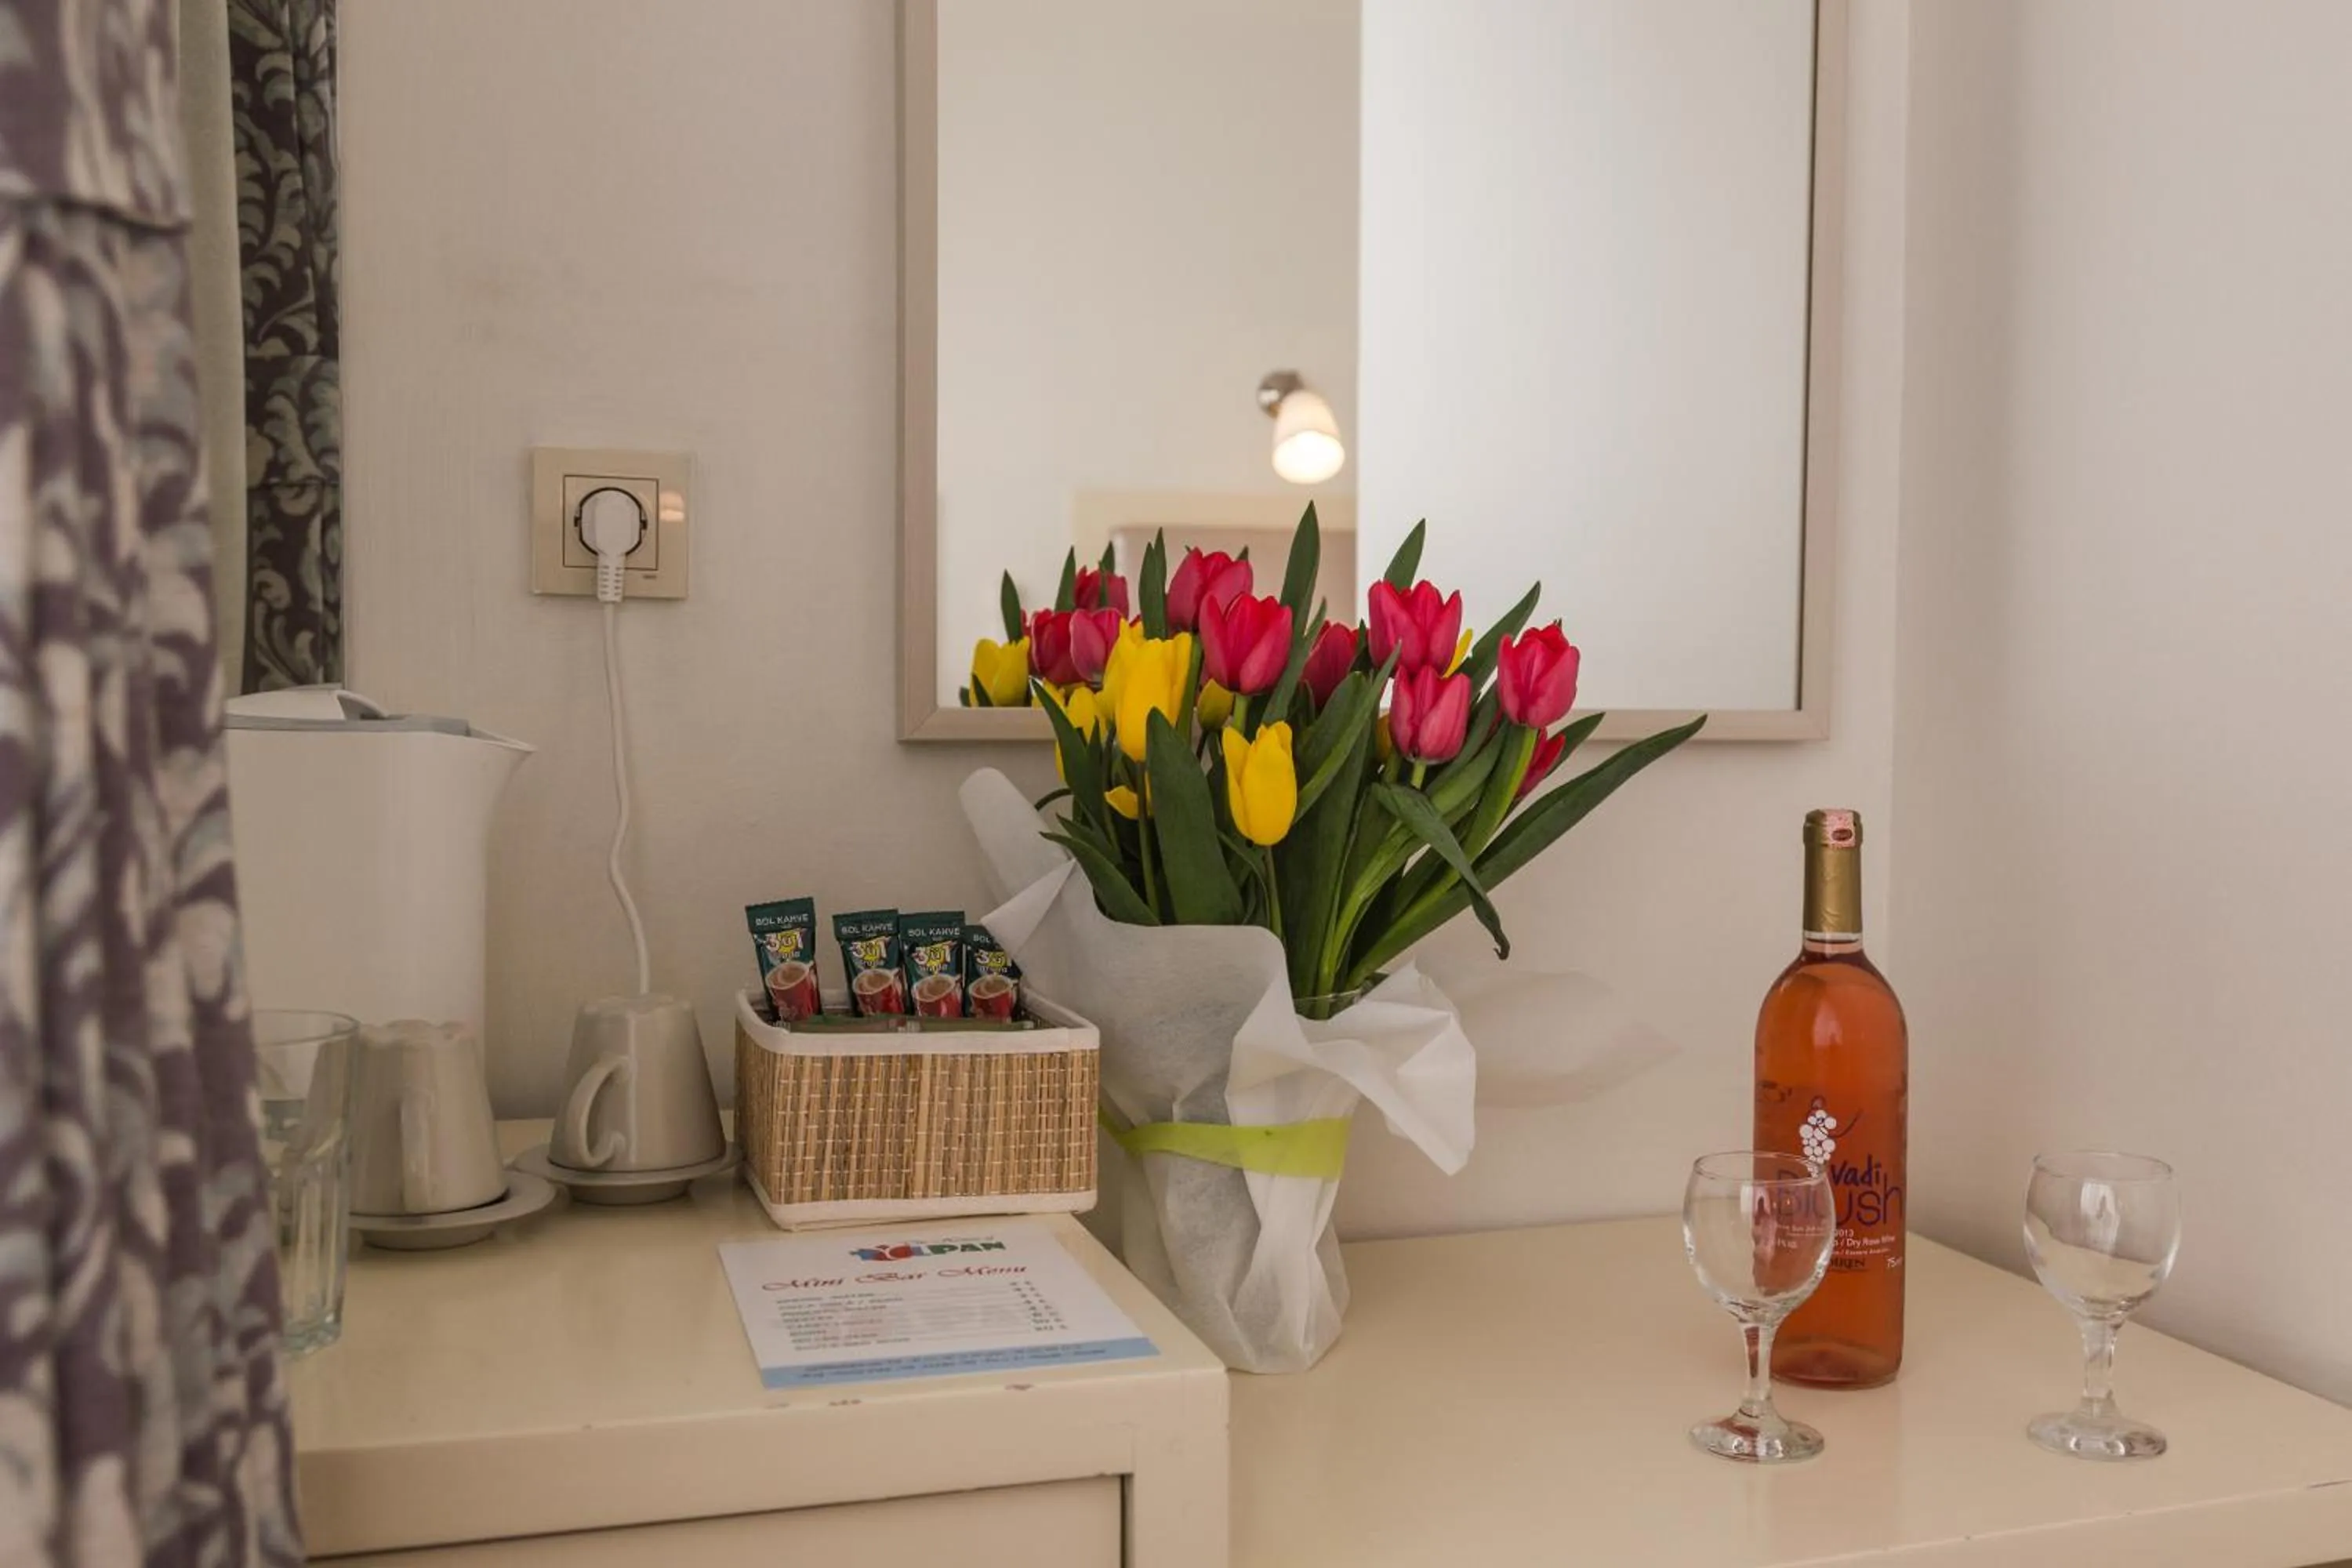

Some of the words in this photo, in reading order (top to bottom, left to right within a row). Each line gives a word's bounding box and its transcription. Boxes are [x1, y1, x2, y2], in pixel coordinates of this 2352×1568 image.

[755, 916, 775, 926] BOL
[777, 913, 809, 924] KAHVE
[841, 926, 861, 935] BOL
[907, 927, 927, 937] BOL
[1846, 1238, 1861, 1249] Dry
[938, 1265, 1028, 1277] Menu
